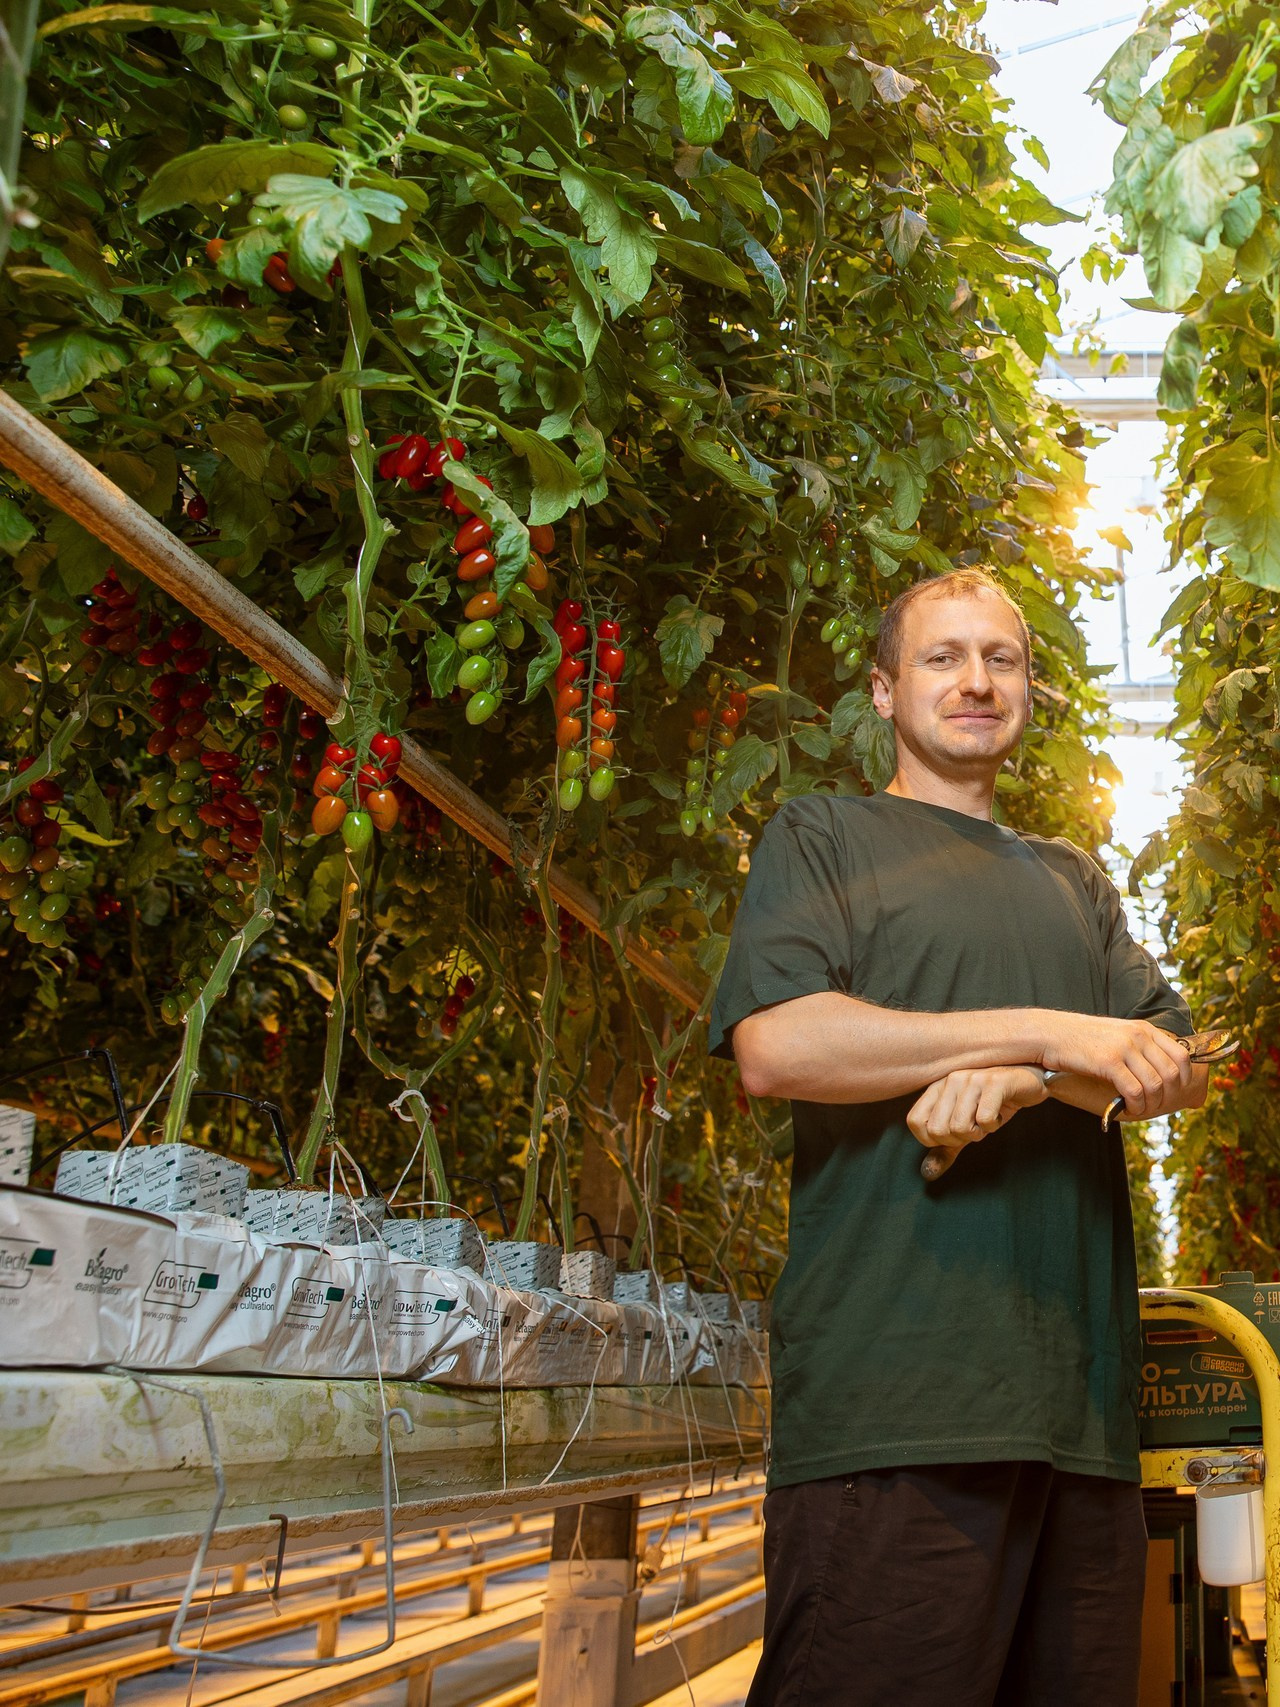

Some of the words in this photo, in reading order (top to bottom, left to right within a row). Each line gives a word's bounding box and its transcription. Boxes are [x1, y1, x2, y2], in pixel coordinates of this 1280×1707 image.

[240, 1301, 276, 1311] cultivation
[1138, 1381, 1247, 1407] ЛЬТУРА
[1158, 1406, 1205, 1418] которых
[1207, 1404, 1248, 1416] уверен
